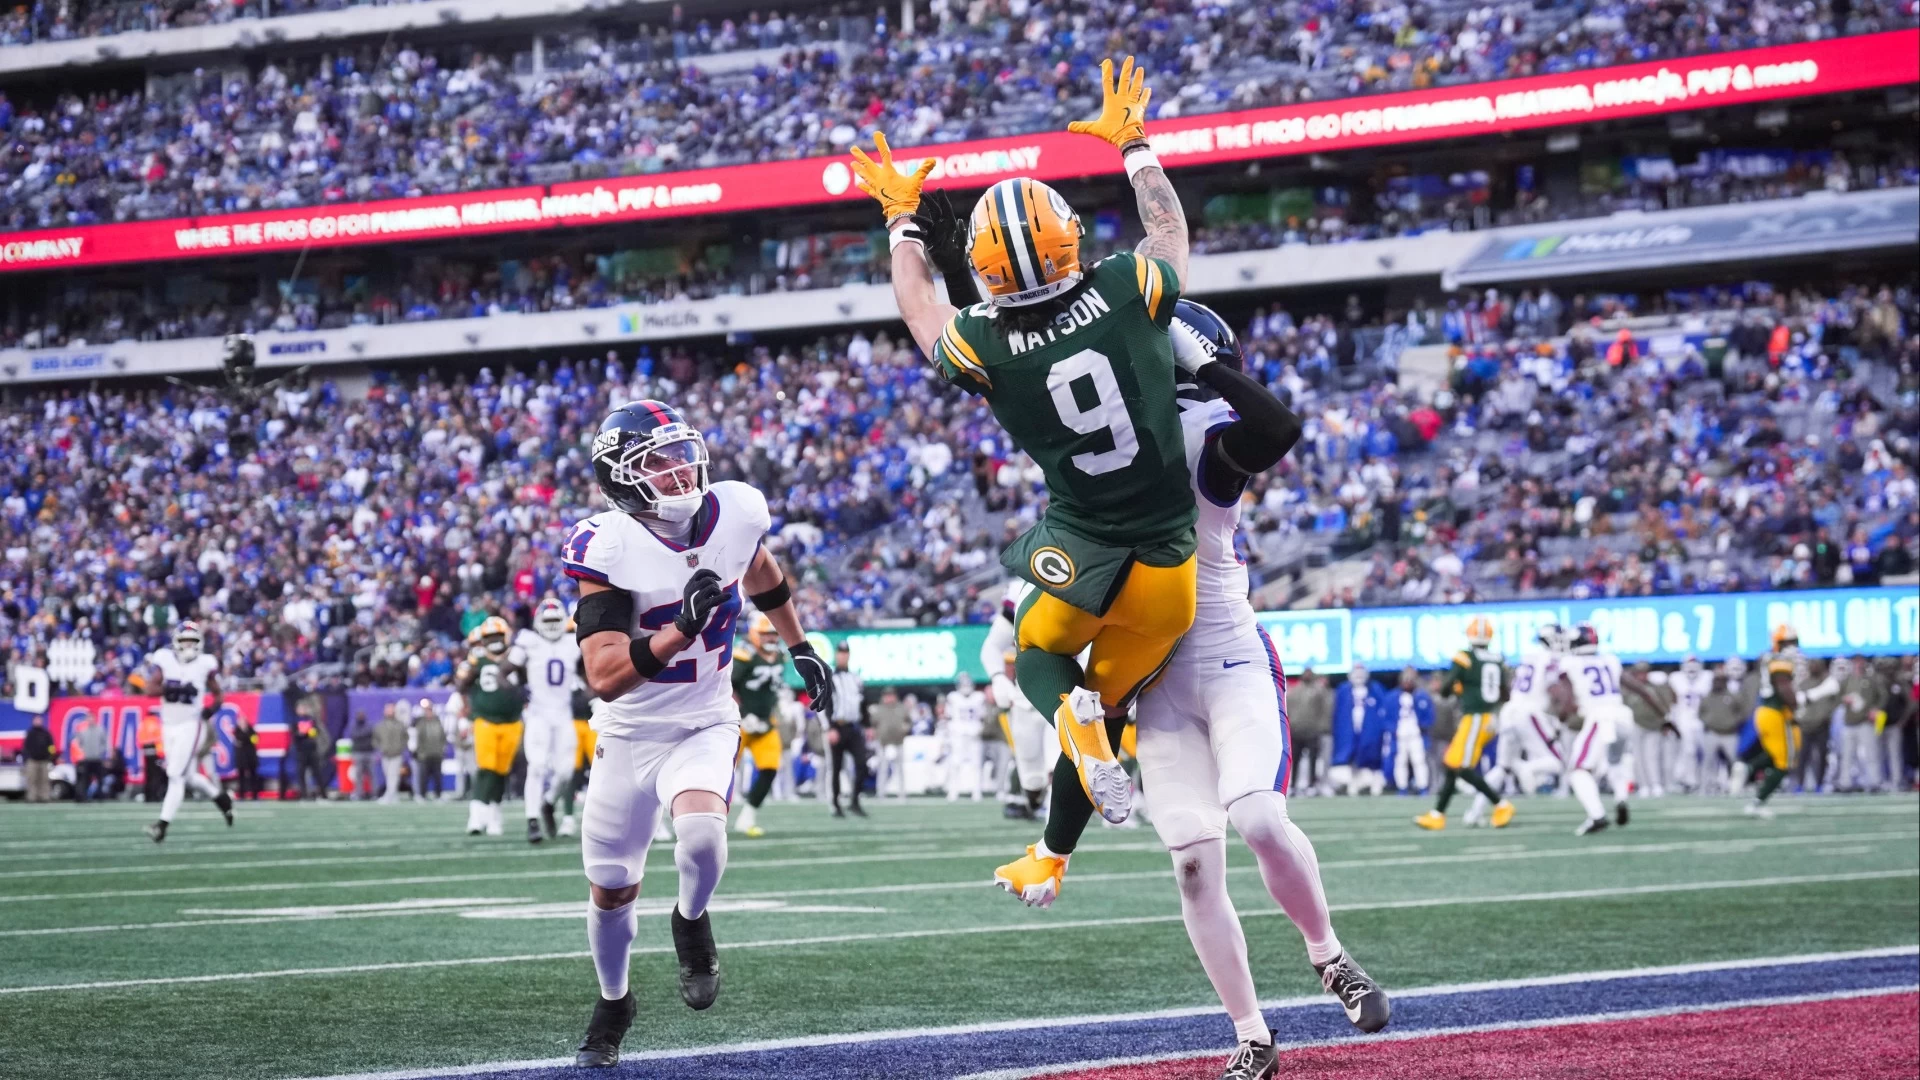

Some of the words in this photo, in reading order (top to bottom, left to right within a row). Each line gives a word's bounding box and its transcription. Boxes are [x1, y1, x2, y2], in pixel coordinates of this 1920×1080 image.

[1215, 123, 1250, 148] THE
[1252, 117, 1304, 144] PROS
[1305, 113, 1340, 139] GO
[1342, 109, 1382, 135] FOR
[1732, 64, 1753, 90] &
[944, 146, 1041, 178] COMPANY
[175, 226, 231, 250] WHERE
[233, 222, 263, 246] THE
[264, 219, 308, 242] PROS
[309, 216, 337, 239] GO
[338, 213, 371, 236] FOR
[653, 186, 671, 208] &
[4, 237, 83, 263] COMPANY
[1557, 226, 1693, 256] MetLife
[1018, 287, 1050, 301] PACKERS
[644, 313, 699, 330] MetLife
[1007, 287, 1111, 356] WATSON
[1180, 321, 1218, 358] ANTS
[32, 357, 60, 370] BUD
[1046, 348, 1140, 477] 9
[561, 525, 596, 564] 24
[1033, 550, 1073, 586] G
[640, 578, 743, 684] 24
[1416, 610, 1558, 665] QUTER
[1662, 612, 1690, 652] &
[1693, 604, 1716, 652] 7
[1844, 598, 1891, 647] ON
[14, 665, 50, 714] D
[480, 664, 501, 692] 6
[547, 659, 565, 686] 0
[1583, 665, 1619, 697] 31
[61, 704, 239, 784] GIAS
